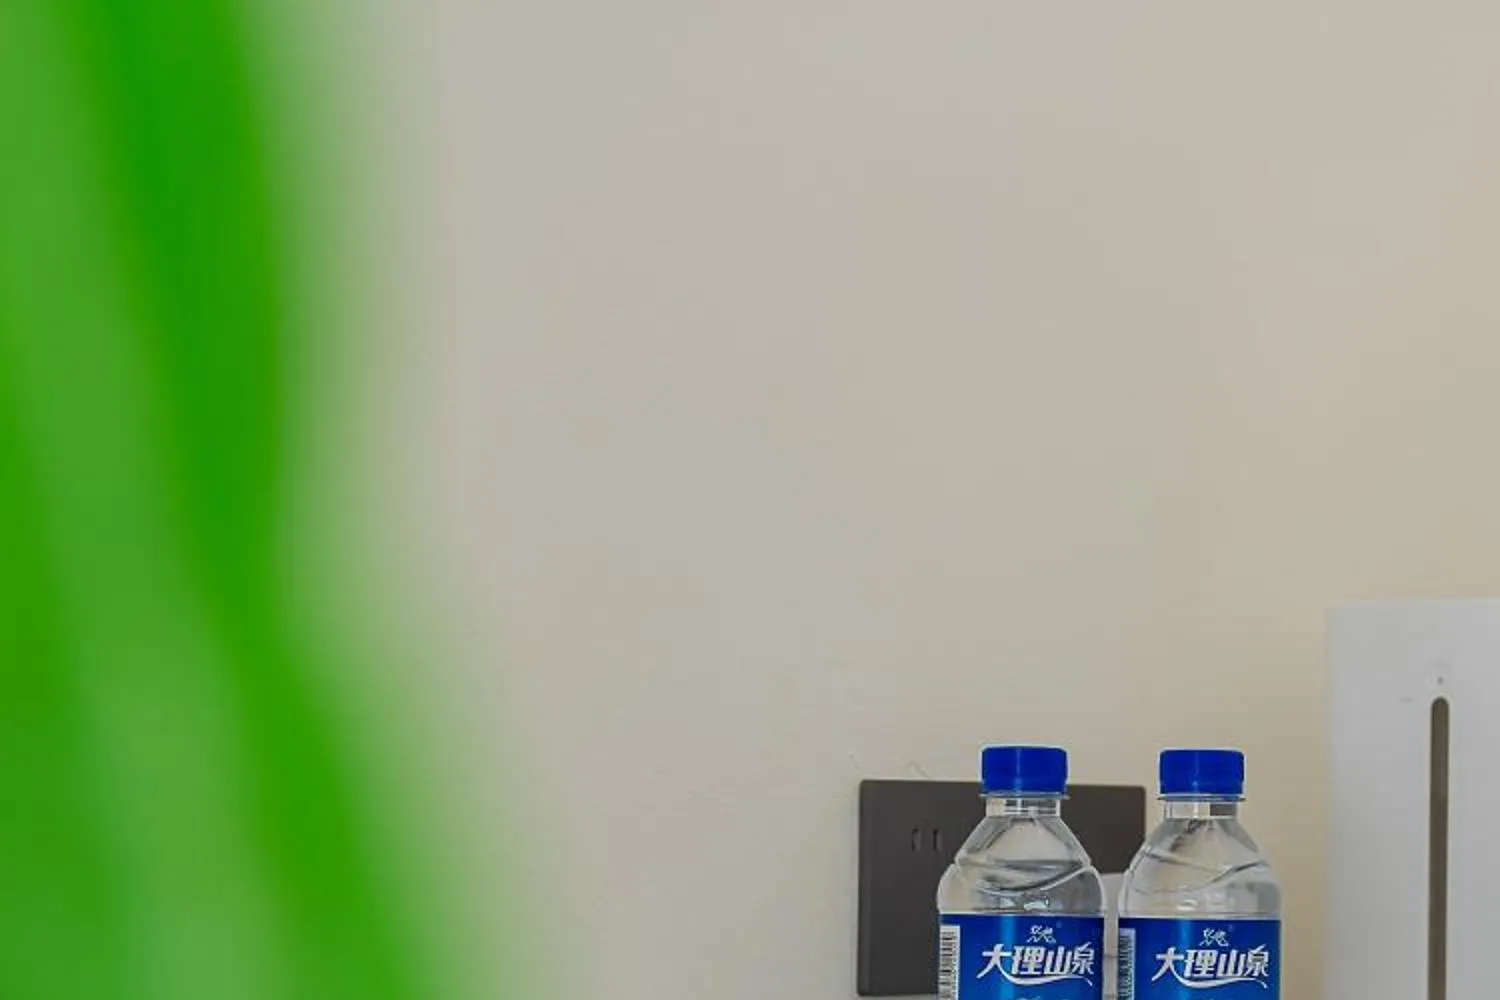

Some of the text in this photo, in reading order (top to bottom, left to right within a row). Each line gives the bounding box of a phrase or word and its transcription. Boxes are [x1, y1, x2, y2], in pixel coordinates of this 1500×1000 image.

[976, 942, 1095, 987] 大理山泉
[1151, 944, 1269, 989] 大理山泉
